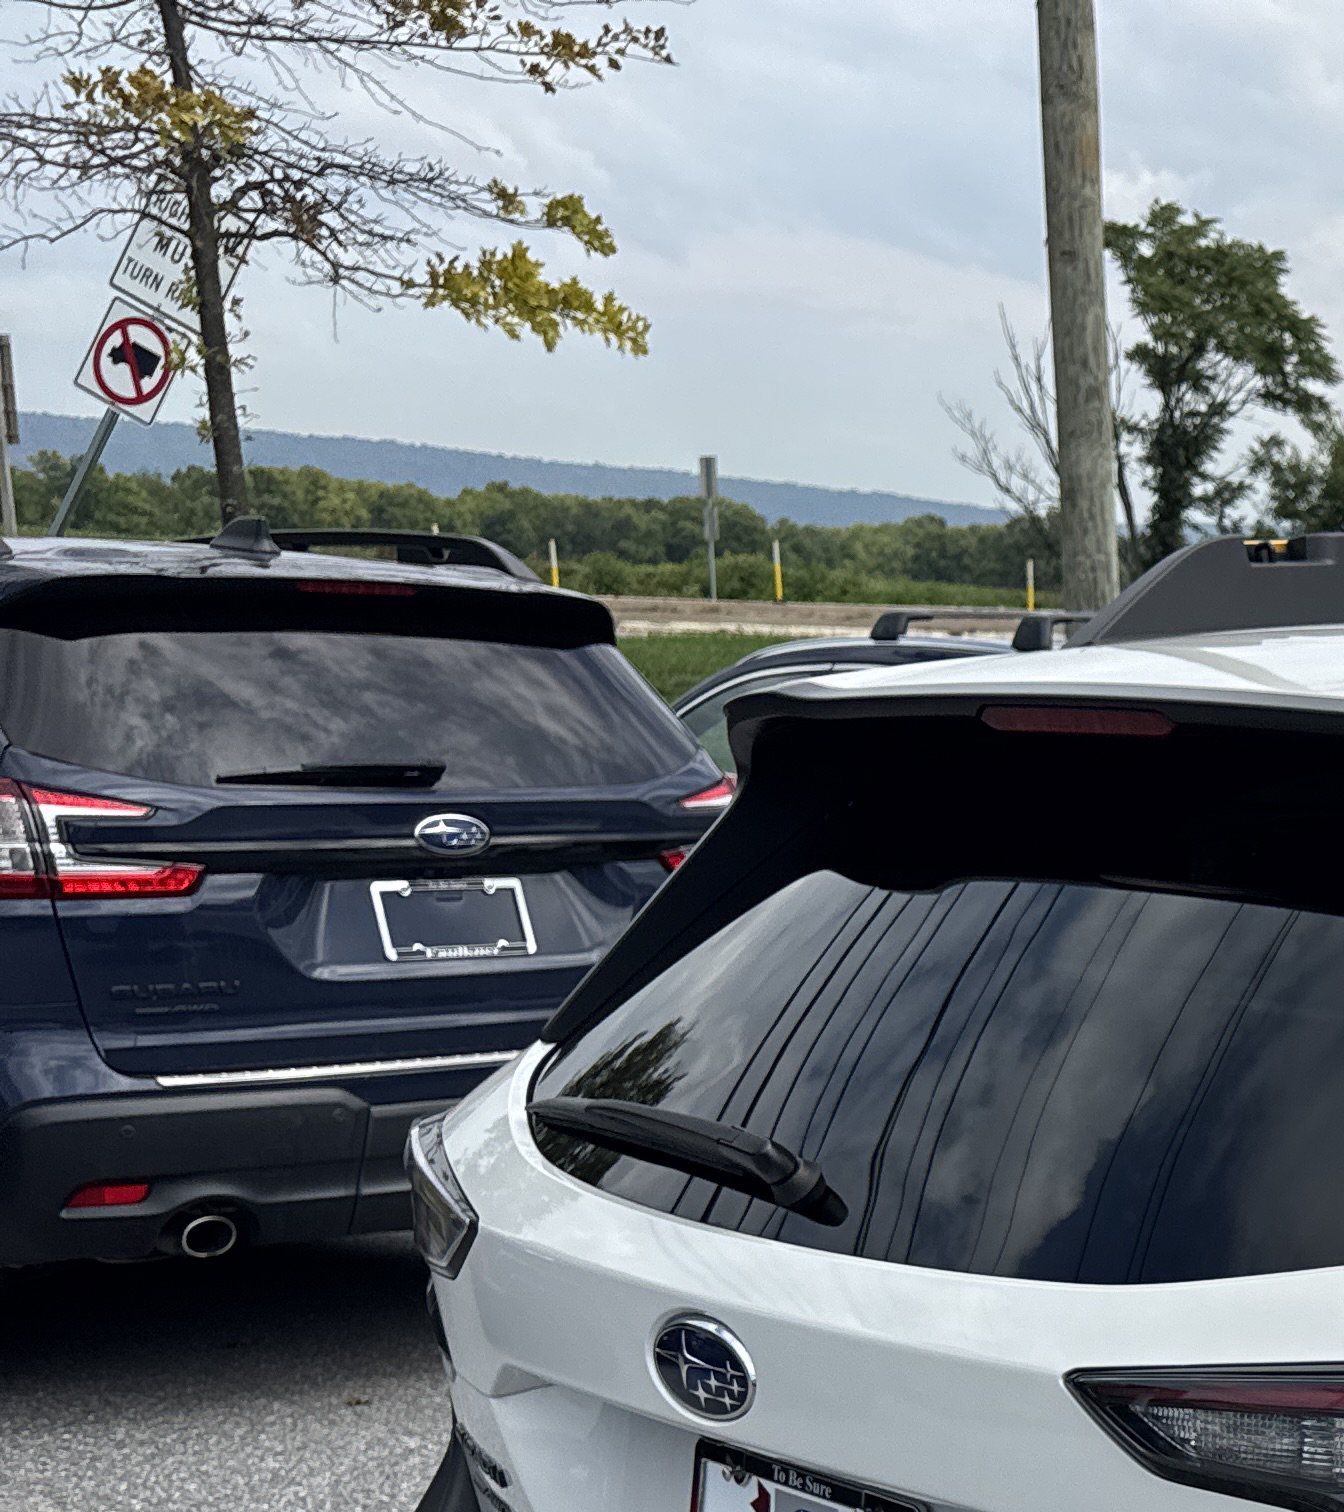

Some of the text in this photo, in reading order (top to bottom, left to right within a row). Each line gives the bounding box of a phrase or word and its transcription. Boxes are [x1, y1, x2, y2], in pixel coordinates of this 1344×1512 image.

[152, 232, 188, 264] MU
[122, 256, 165, 293] TURN
[772, 1464, 832, 1499] To Be Sure
